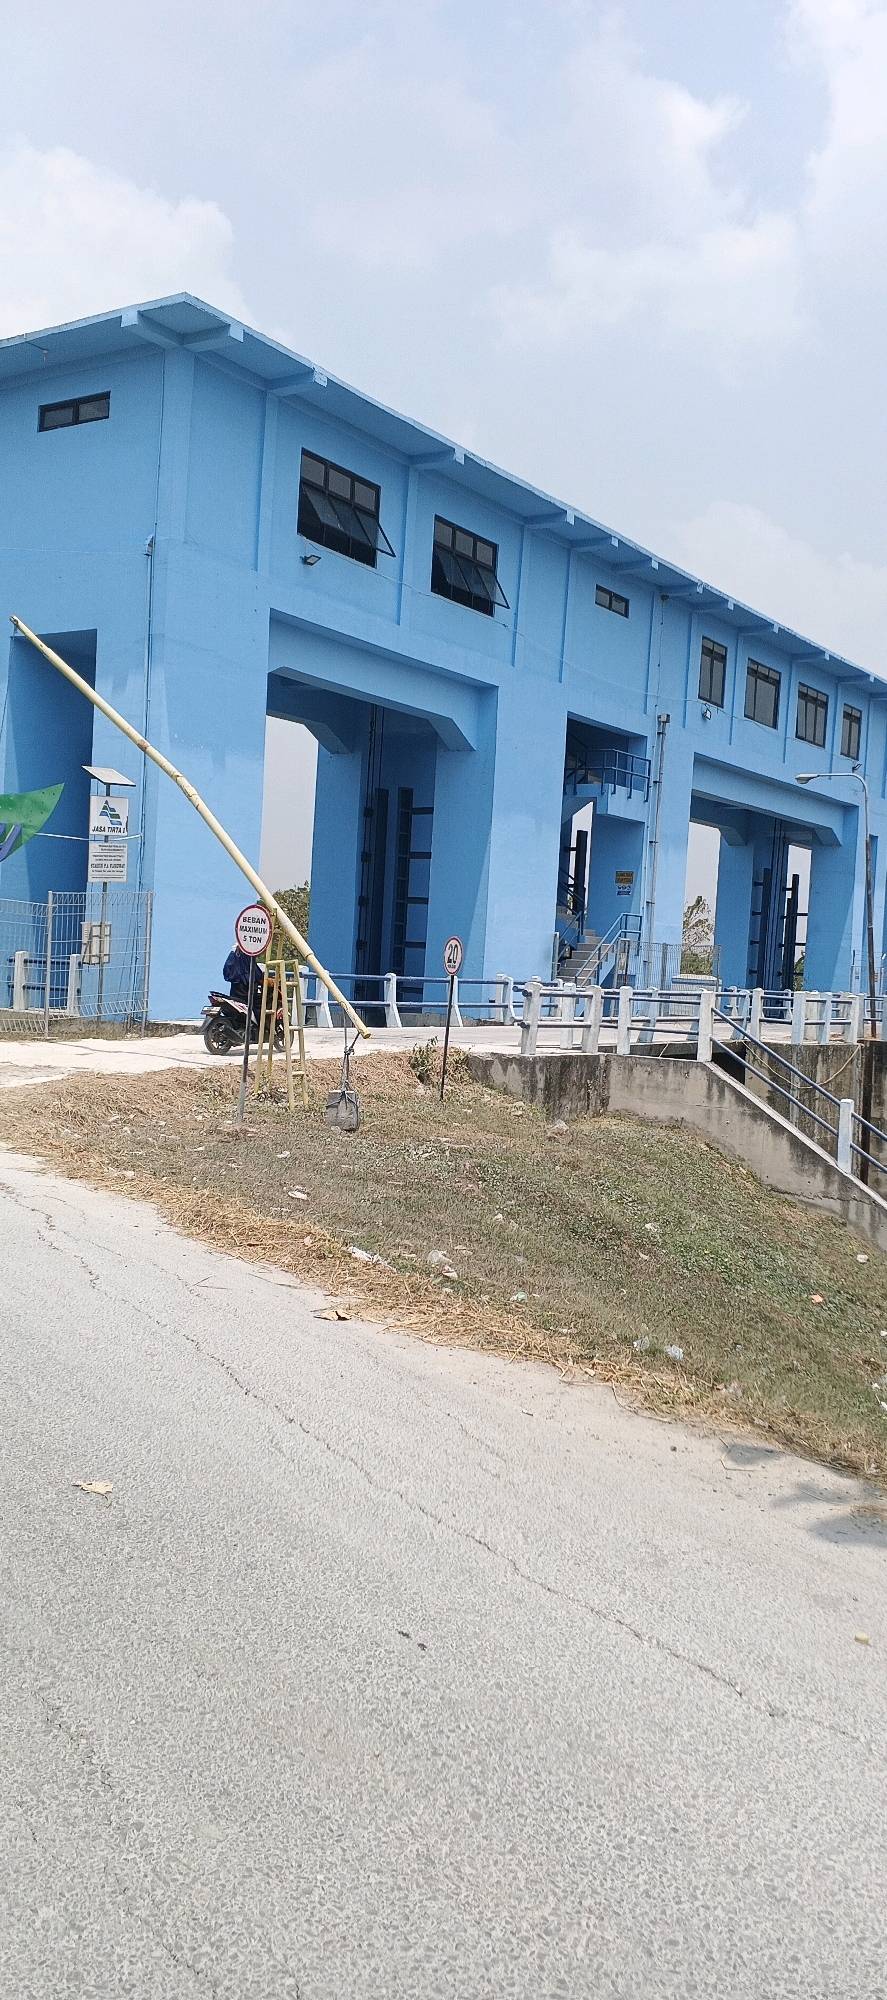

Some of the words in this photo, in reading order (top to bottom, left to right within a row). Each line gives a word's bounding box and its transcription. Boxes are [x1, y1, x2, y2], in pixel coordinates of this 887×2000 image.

[242, 916, 266, 924] BEBAN
[239, 925, 268, 935] MAXIMUM
[248, 936, 262, 944] TON
[446, 944, 458, 964] 20
